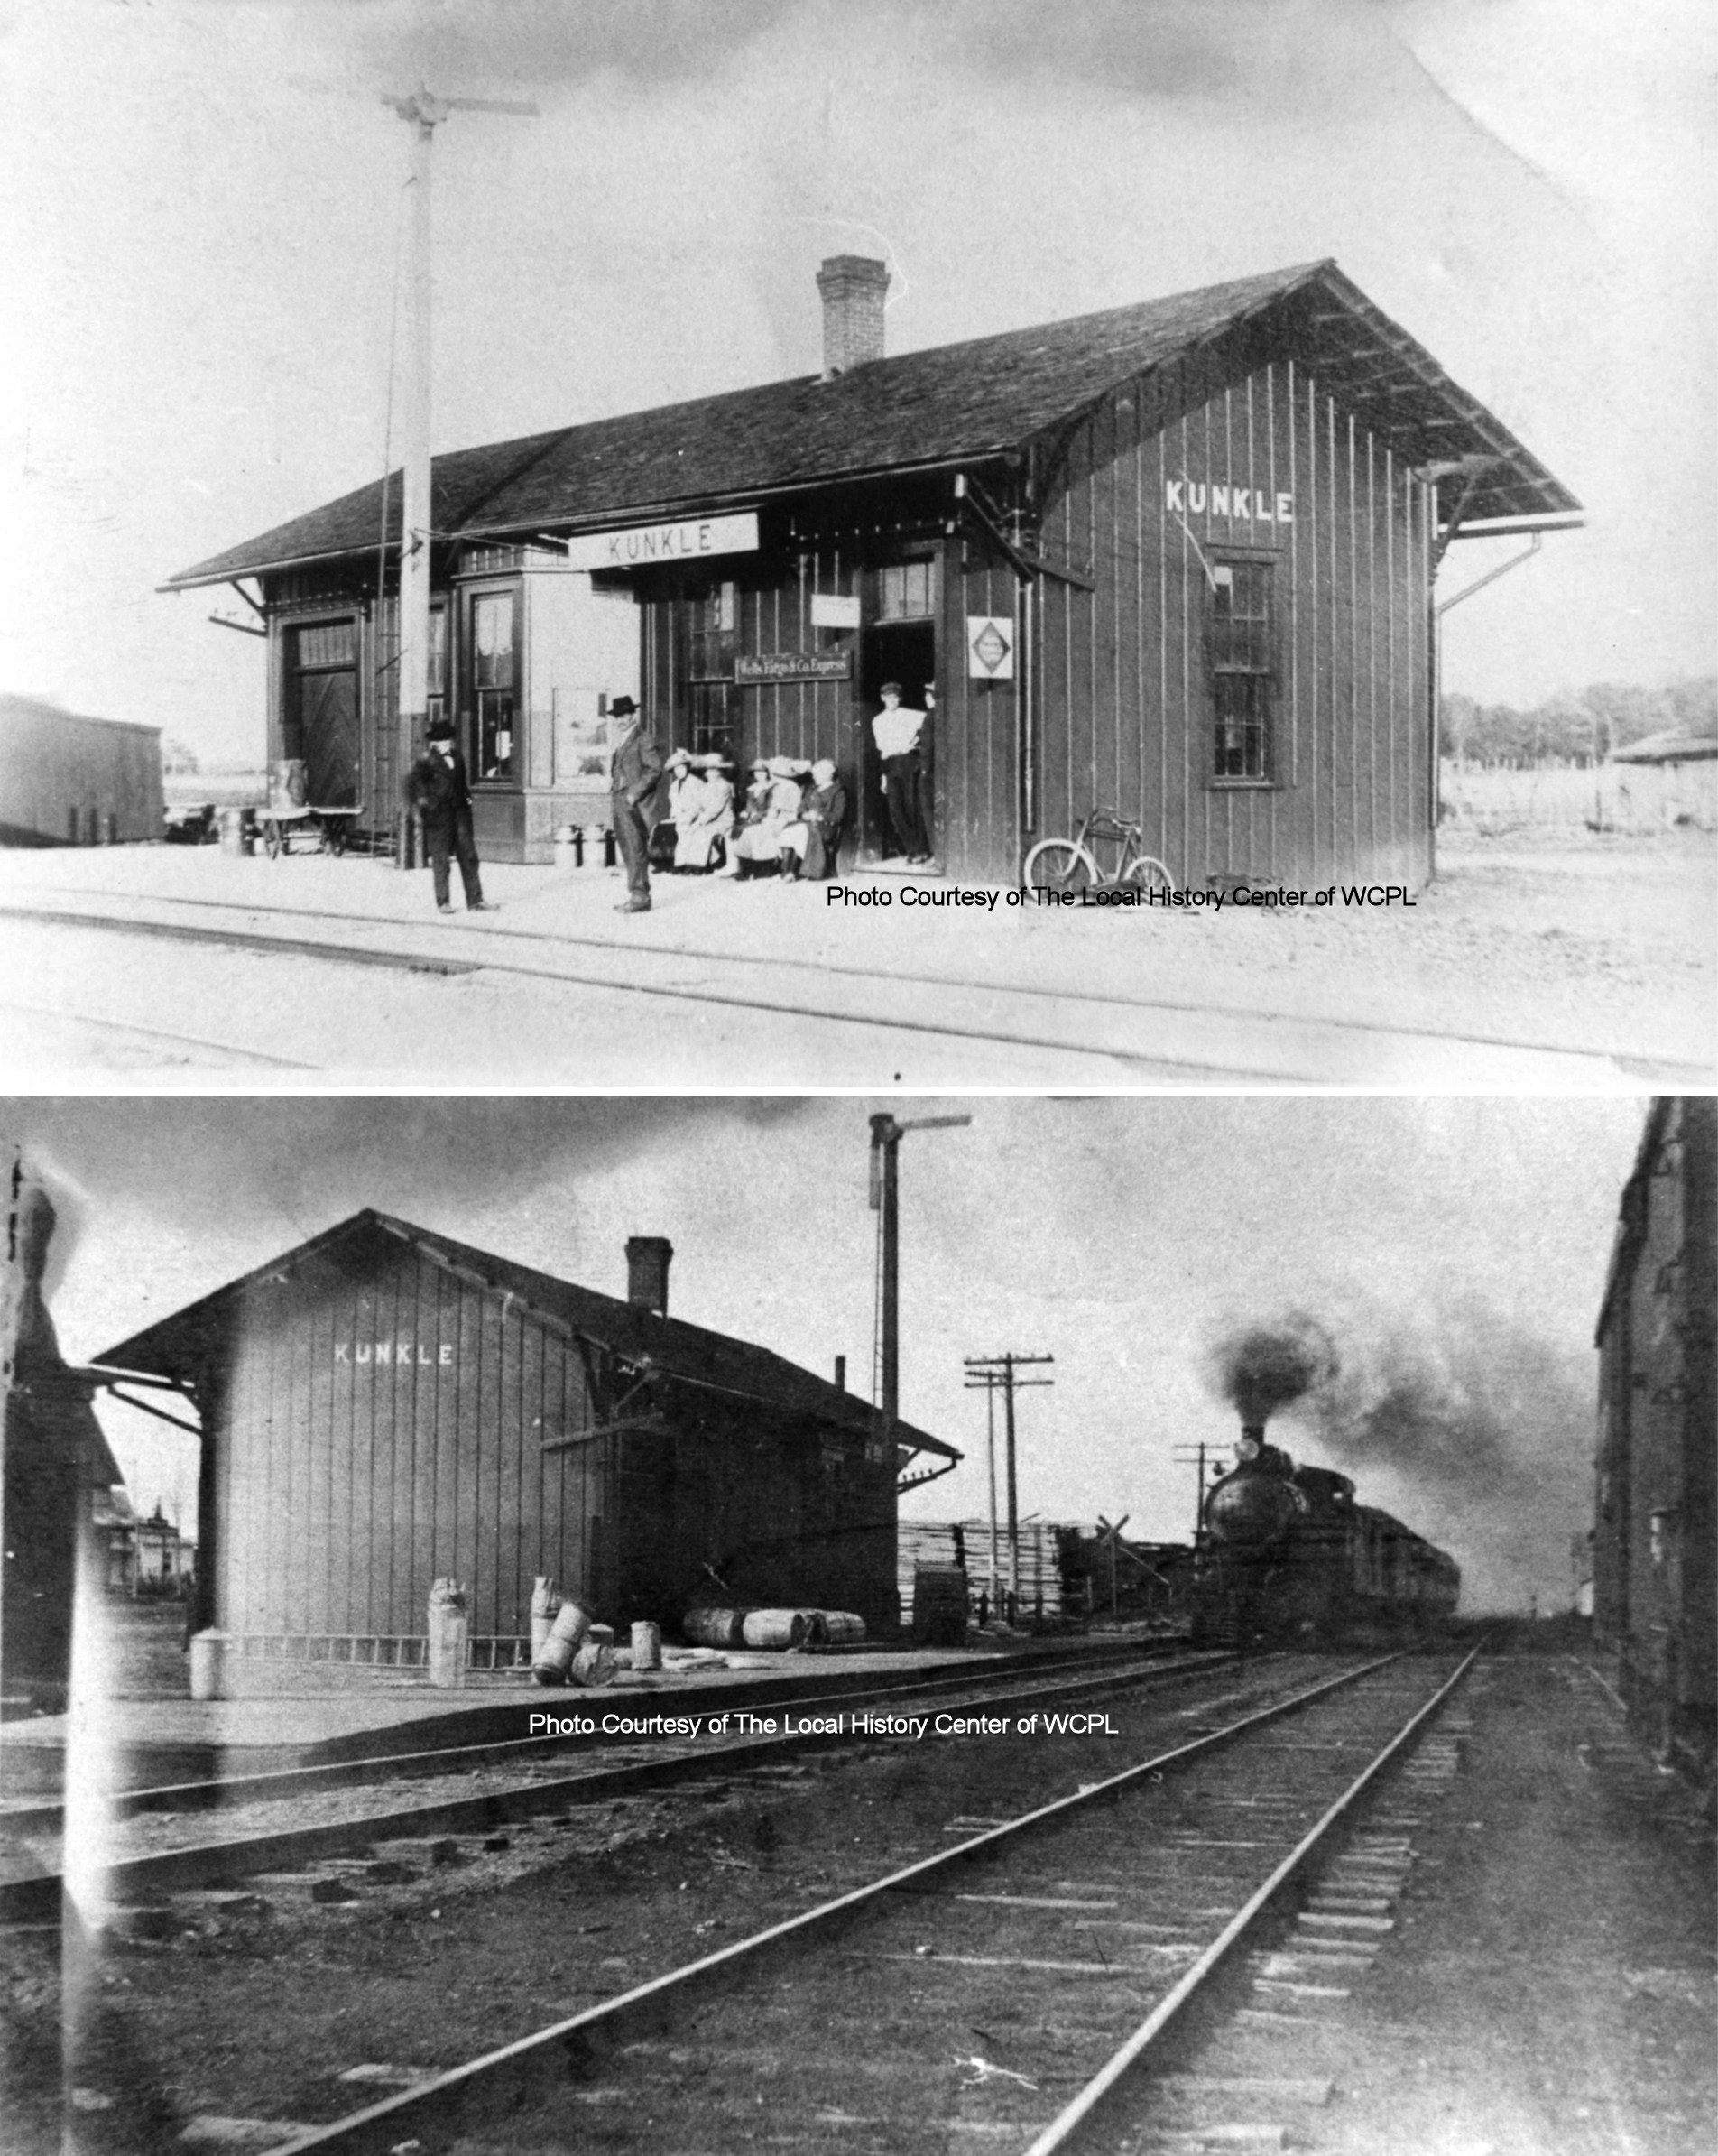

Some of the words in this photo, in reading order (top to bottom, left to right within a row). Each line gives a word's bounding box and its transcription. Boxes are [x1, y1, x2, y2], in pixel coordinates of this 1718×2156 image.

[1166, 480, 1294, 523] KUNKLE
[608, 524, 712, 560] KUNKLE
[334, 1343, 454, 1365] KUNKLE
